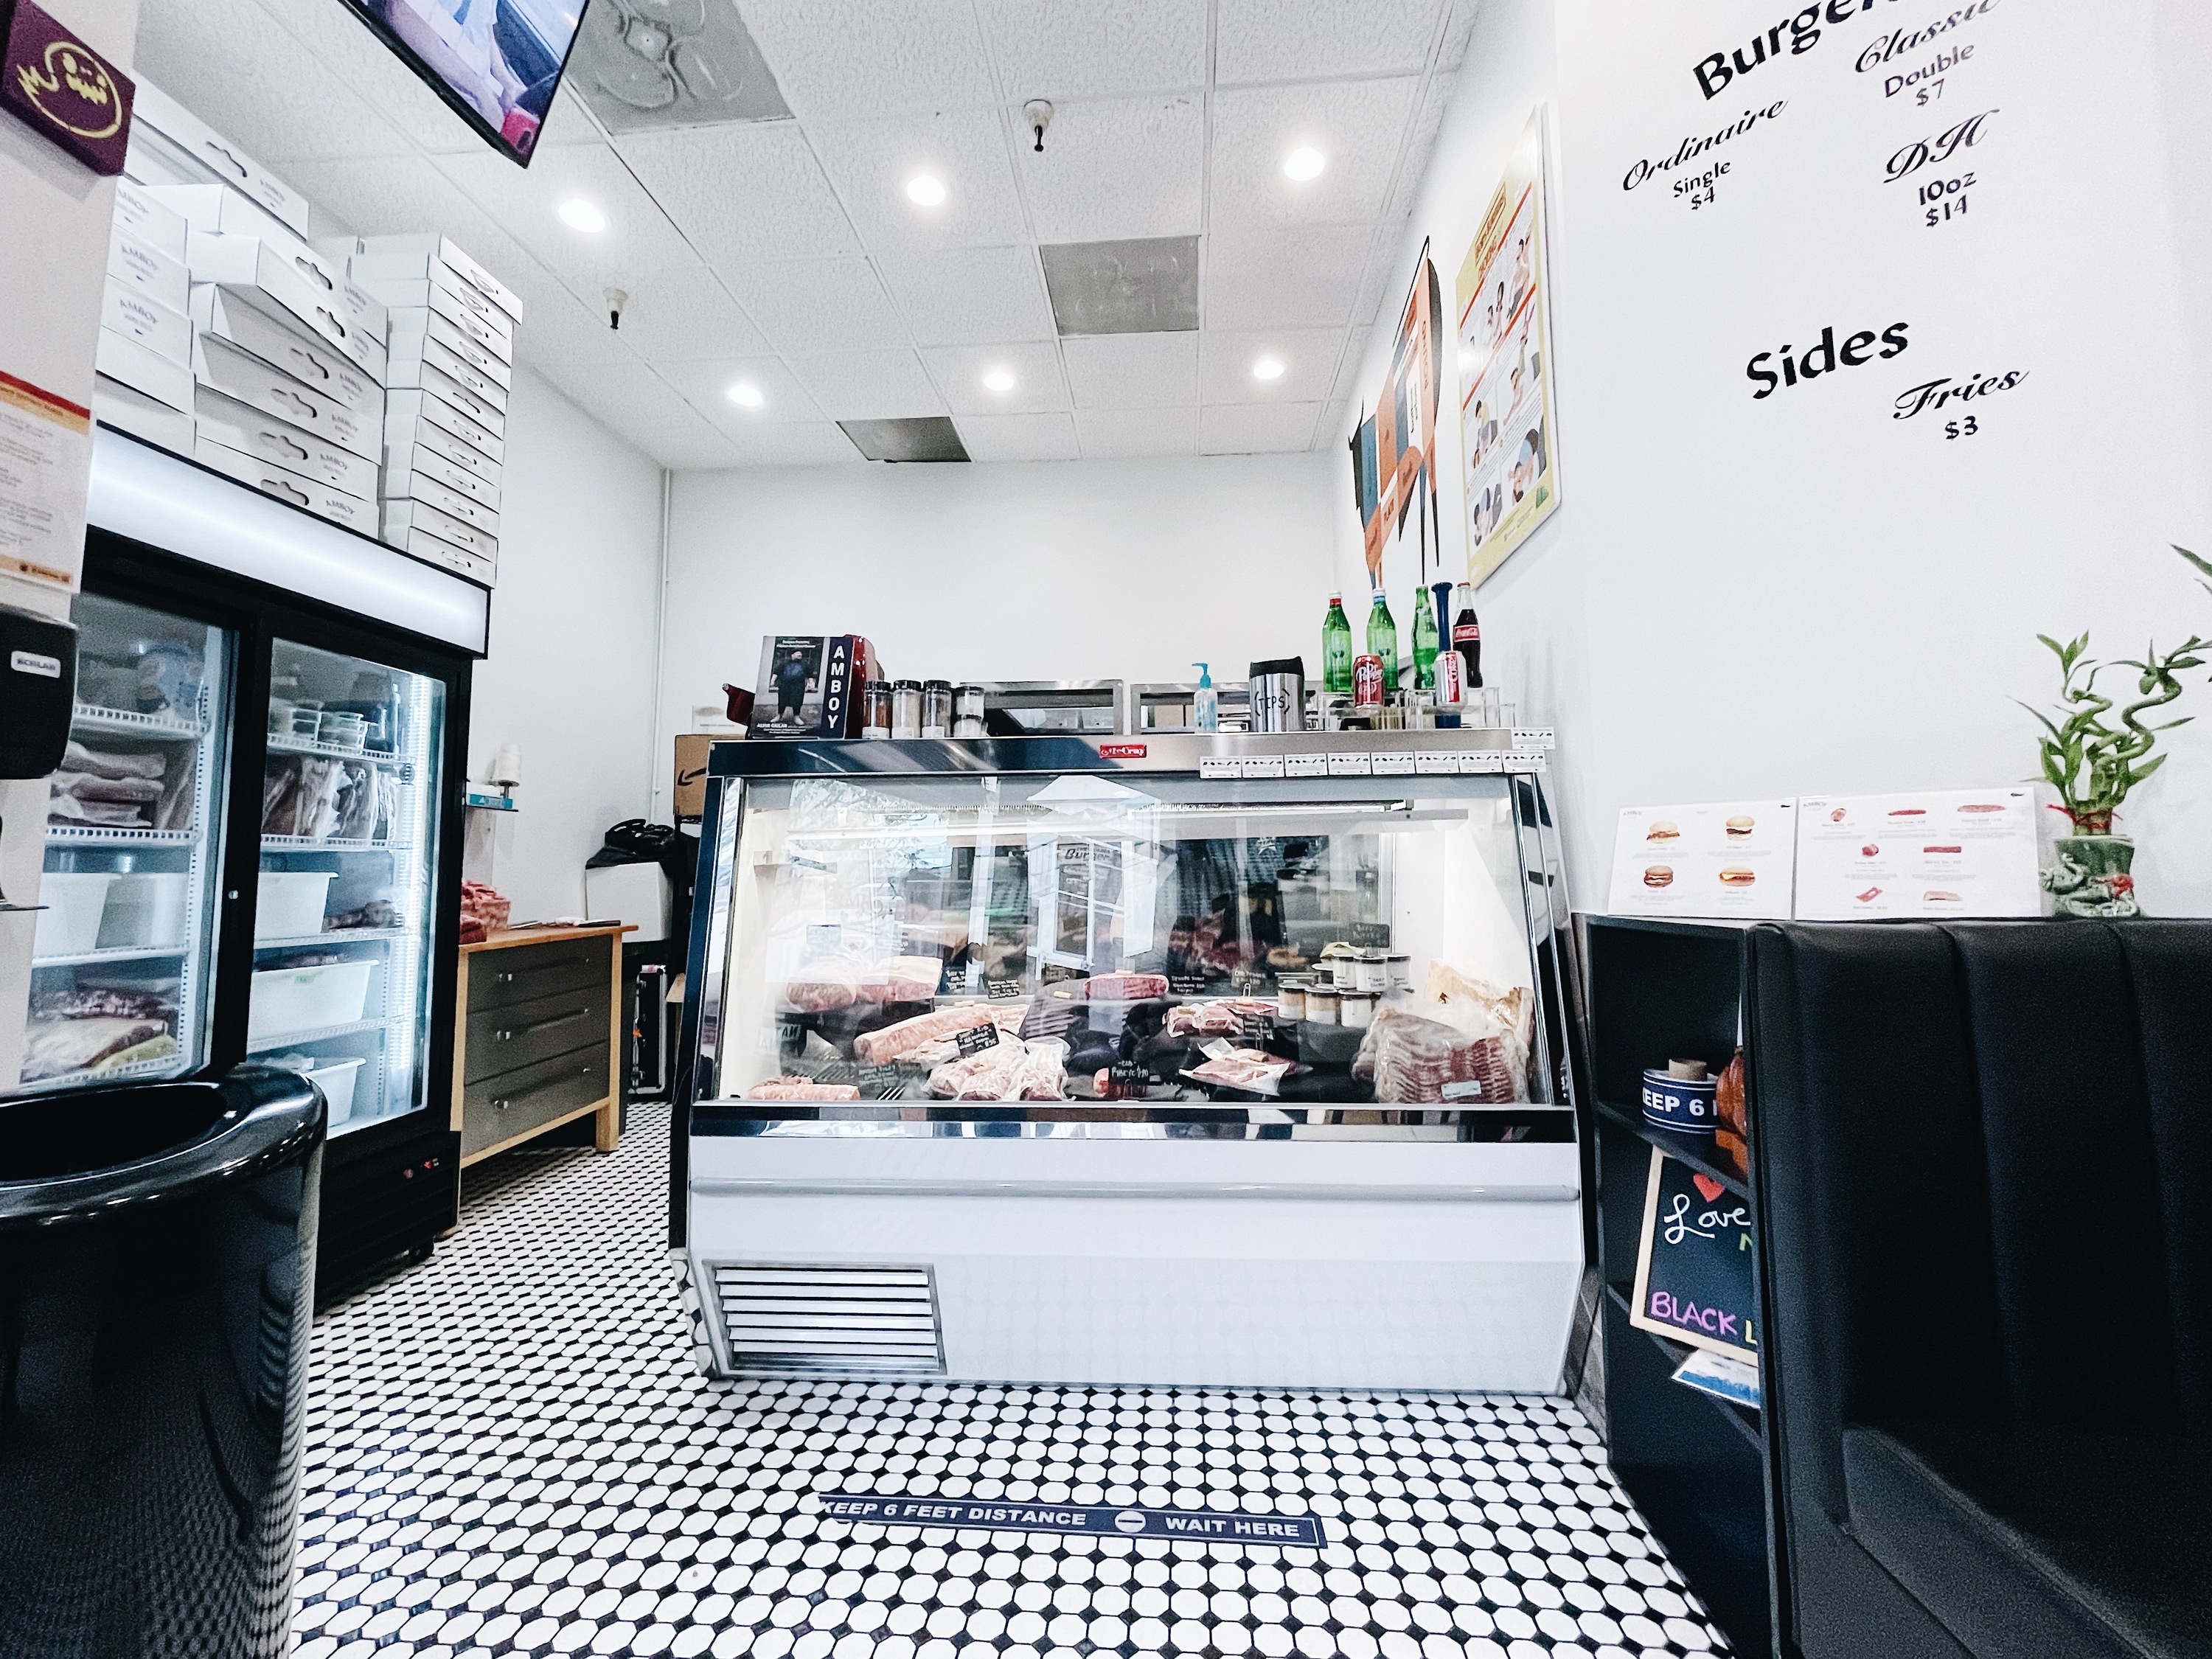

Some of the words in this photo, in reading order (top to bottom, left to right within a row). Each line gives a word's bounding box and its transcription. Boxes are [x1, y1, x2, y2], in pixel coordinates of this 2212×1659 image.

[1693, 0, 1898, 101] Burge
[1885, 42, 1975, 98] Double
[1917, 79, 1946, 106] $7
[1624, 100, 1789, 192] Ordinaire
[1673, 160, 1731, 198] Single
[1691, 187, 1716, 211] $4
[1919, 172, 1977, 206] 10oz
[1926, 195, 1968, 228] $14
[1746, 322, 1909, 399] Sides
[1893, 370, 2030, 420] Fries
[1945, 416, 1978, 440] $3
[827, 645, 845, 729] AMBOY
[1689, 1099, 1705, 1116] 6
[1663, 1194, 1751, 1245] Love
[1651, 1291, 1739, 1336] BLACK
[883, 1503, 898, 1517] 6
[903, 1504, 962, 1519] FEET
[967, 1508, 1086, 1526] DISTANCE
[1166, 1517, 1226, 1533] WAIT
[1234, 1520, 1300, 1537] HERE
